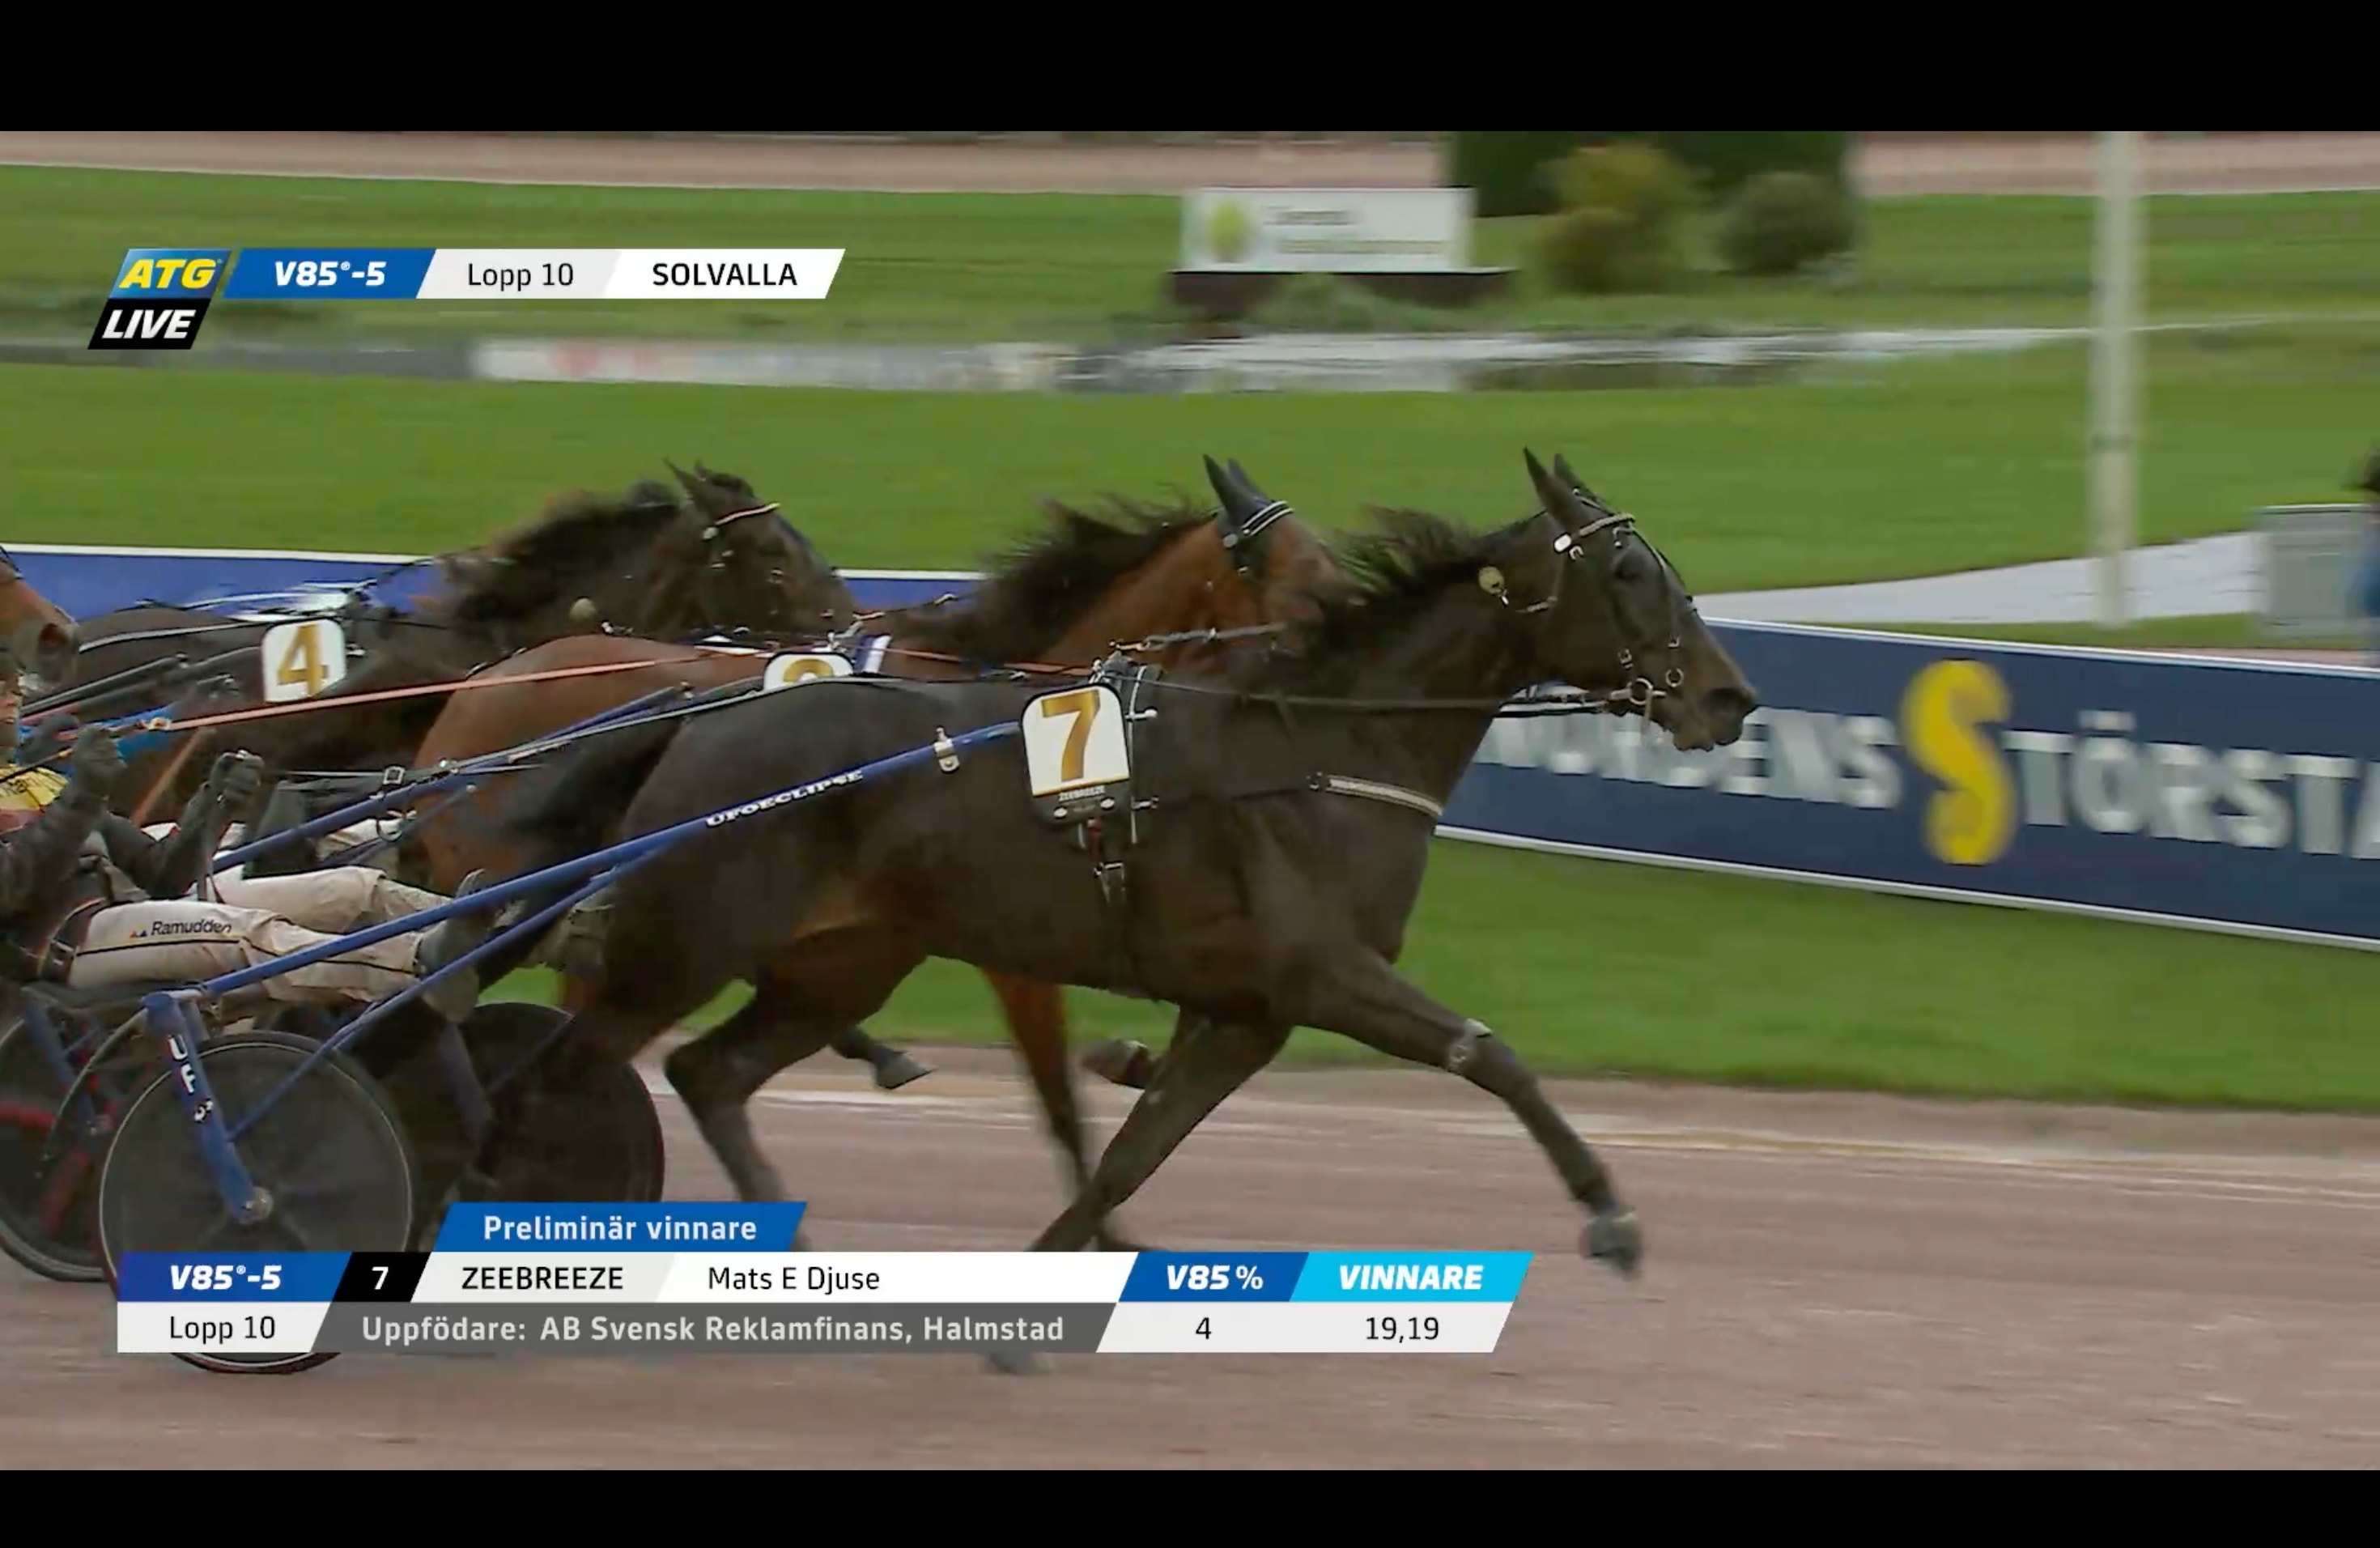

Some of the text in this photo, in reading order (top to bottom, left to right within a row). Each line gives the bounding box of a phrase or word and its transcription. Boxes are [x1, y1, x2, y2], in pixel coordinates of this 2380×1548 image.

[277, 624, 329, 695] 4
[1040, 689, 1102, 783] 7
[151, 919, 232, 936] Ramudden
